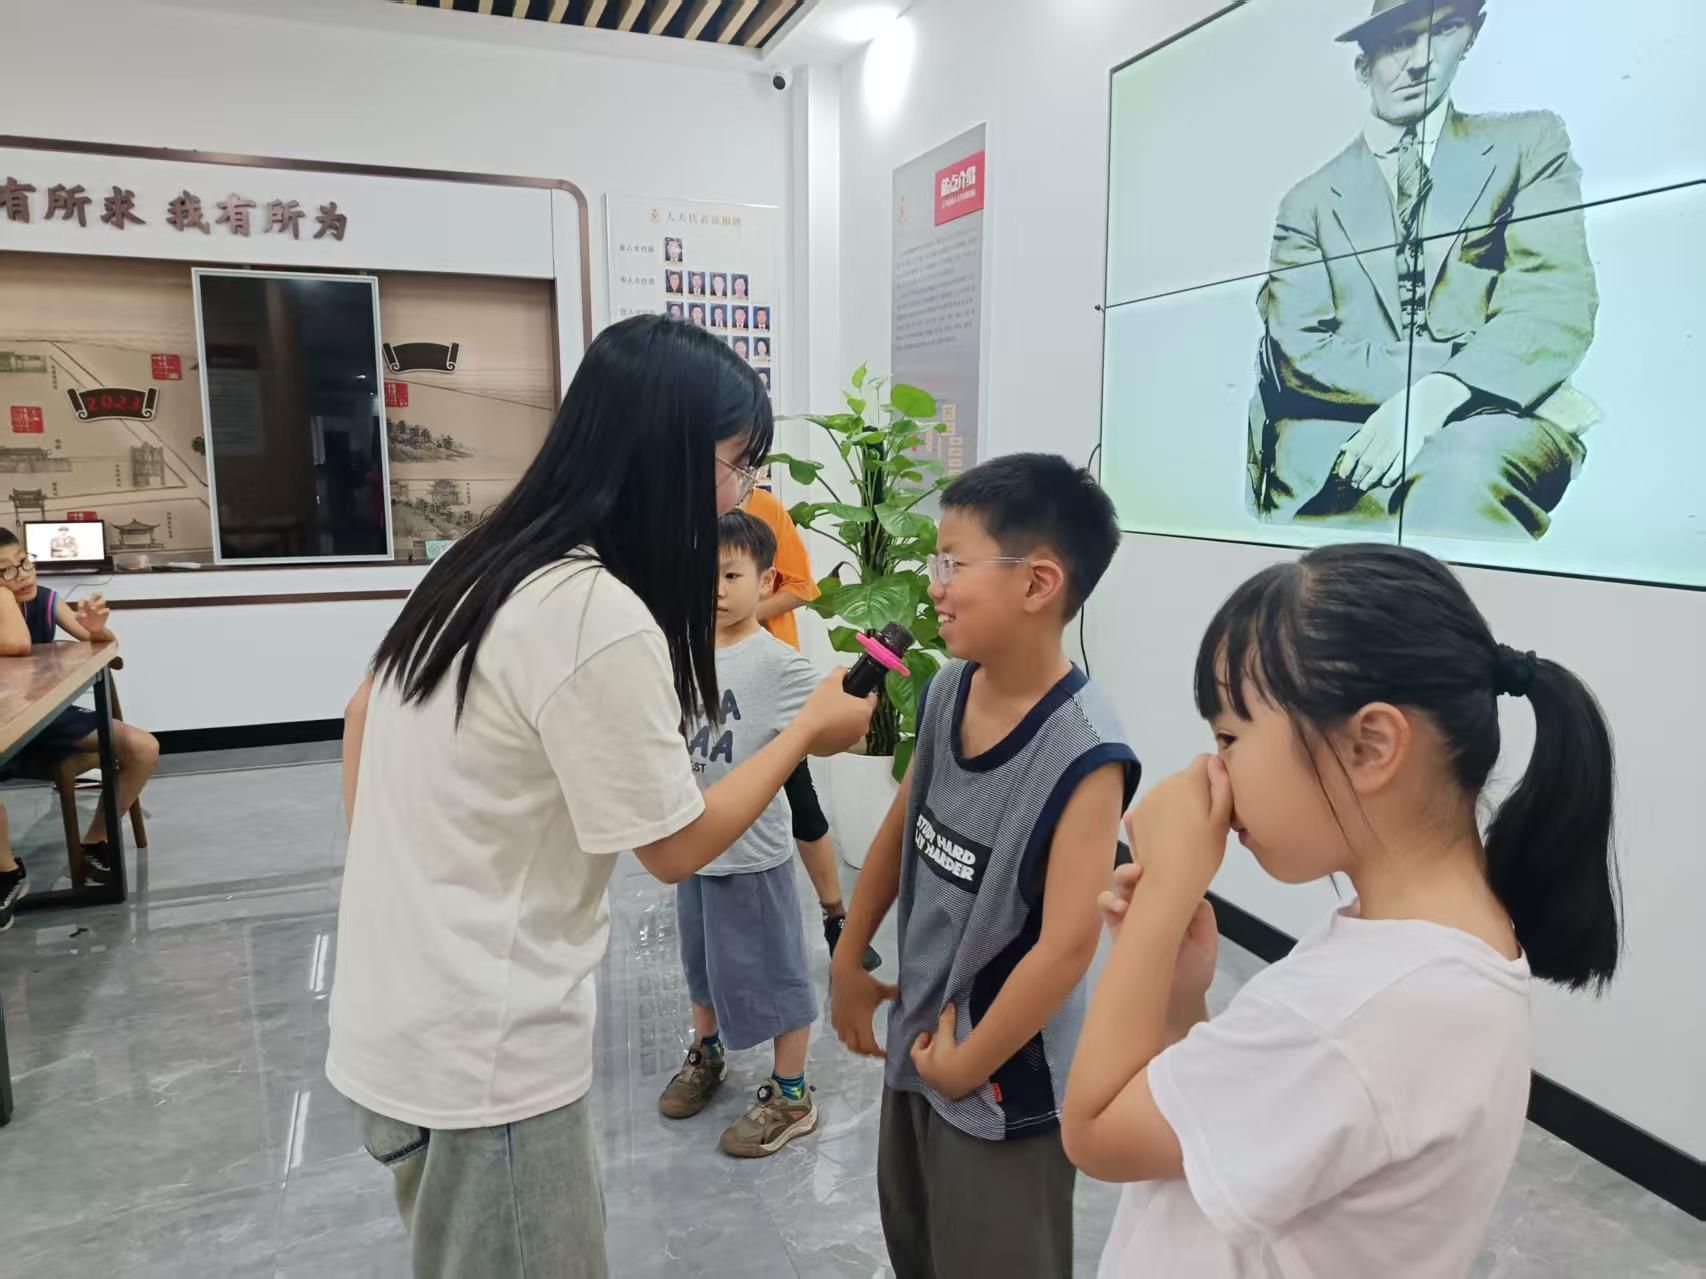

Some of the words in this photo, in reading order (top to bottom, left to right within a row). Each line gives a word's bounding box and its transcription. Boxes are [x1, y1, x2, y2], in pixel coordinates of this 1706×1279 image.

[0, 176, 147, 231] 有所求
[166, 190, 348, 241] 我有所为
[924, 842, 975, 881] HARDER
[937, 834, 976, 865] HARD
